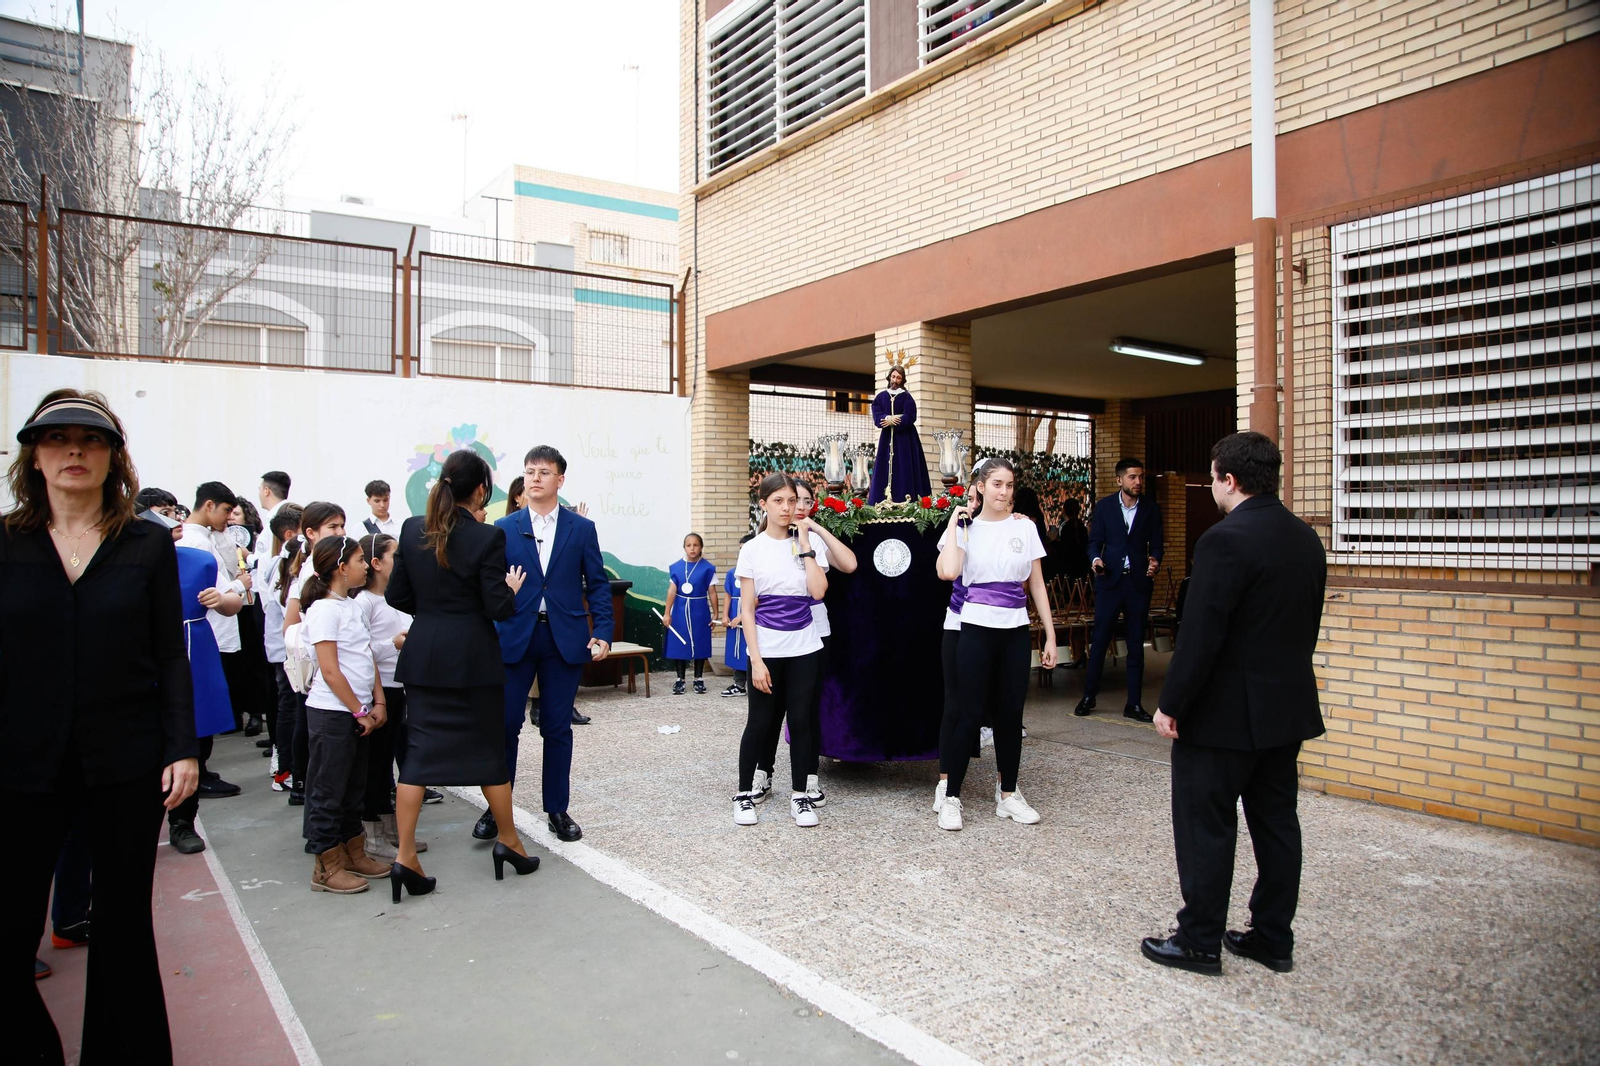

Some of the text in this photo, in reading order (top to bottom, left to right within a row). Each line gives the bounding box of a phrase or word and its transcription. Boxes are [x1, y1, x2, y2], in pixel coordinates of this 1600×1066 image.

[577, 431, 672, 463] Verde que te
[605, 470, 644, 490] quiero
[597, 492, 651, 517] Verde
